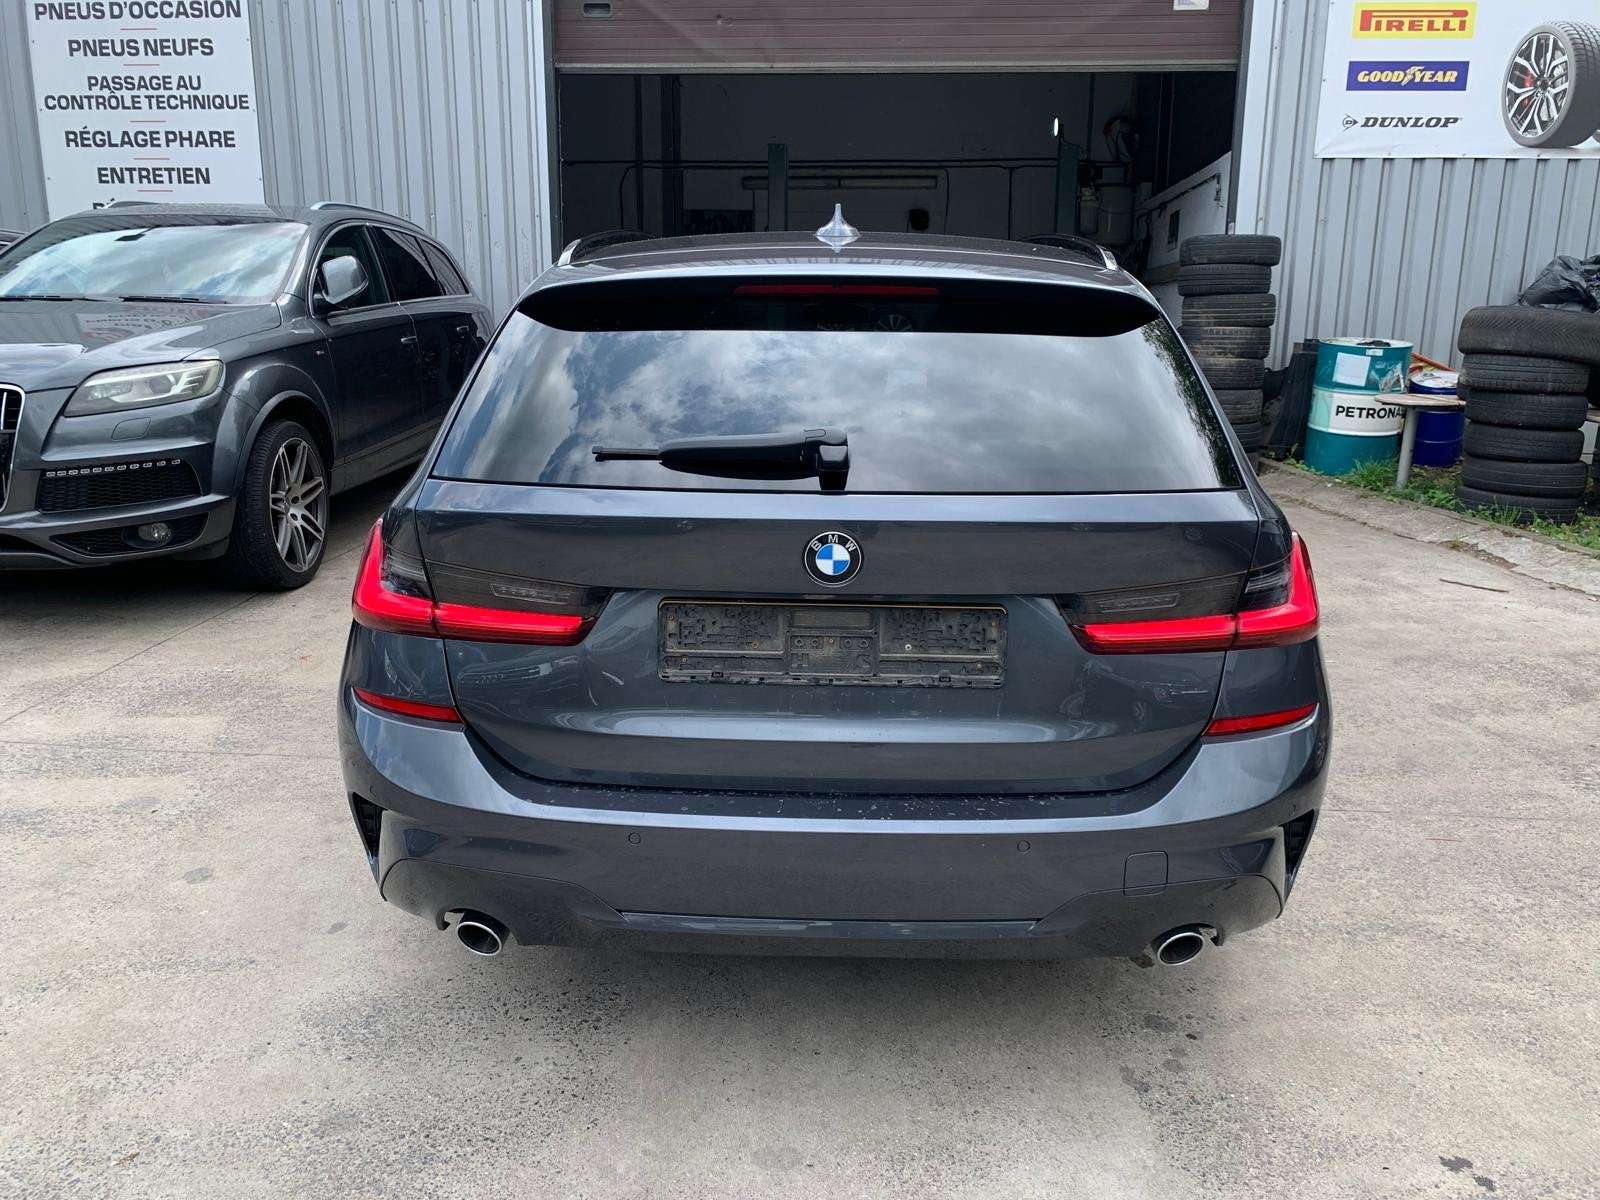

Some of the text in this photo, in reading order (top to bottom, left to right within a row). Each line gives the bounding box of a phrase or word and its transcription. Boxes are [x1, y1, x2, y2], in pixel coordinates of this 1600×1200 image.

[34, 0, 242, 20] PNEUS D'OCCASION
[1359, 9, 1469, 31] PIRELLI
[67, 38, 214, 57] PNEUS NEUFS
[87, 76, 202, 91] PASSAGE AU
[44, 91, 249, 110] CONTRÔLE TECHNIQUE
[1360, 116, 1460, 128] DUNLOP
[64, 126, 236, 148] RÉGLAGE PHARE
[97, 168, 211, 185] ENTRETIEN
[810, 534, 857, 552] BMW
